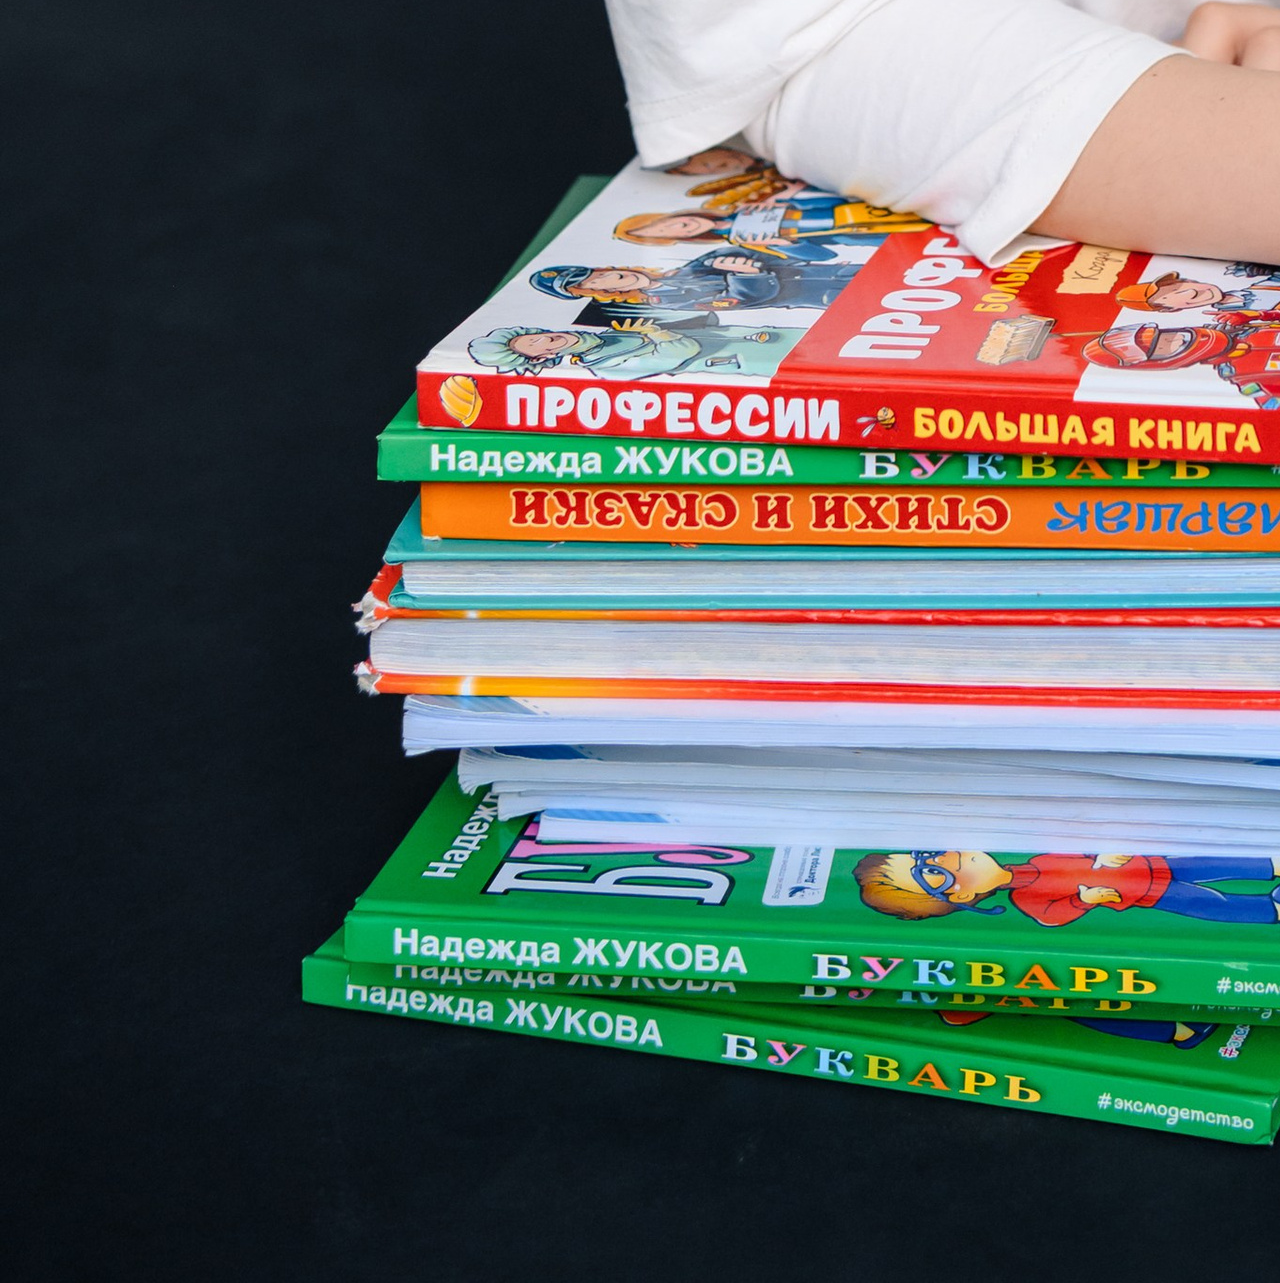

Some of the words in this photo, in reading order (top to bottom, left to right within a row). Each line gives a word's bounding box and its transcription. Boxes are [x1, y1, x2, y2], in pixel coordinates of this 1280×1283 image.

[505, 383, 841, 441] ПРОФЕССИИ
[913, 406, 1115, 447] БОЛЬШАЯ
[1128, 417, 1262, 454] КНИГА
[430, 443, 602, 478] Надежда
[612, 445, 795, 477] ЖУКОВА
[858, 451, 1211, 481] БУКВАРЬ
[508, 486, 740, 530] СКАЗКИ
[751, 490, 794, 532] И
[809, 492, 1011, 534] СТИХИ
[393, 927, 561, 967] Надежда
[571, 936, 749, 975] ЖУКОВА
[811, 952, 1158, 996] БУКВАРЬ
[345, 983, 495, 1024] Надежда
[503, 997, 664, 1048] ЖУКОВА
[720, 1032, 1043, 1104] БУКВАРЬ
[1097, 1092, 1255, 1131] #эксмодетство
